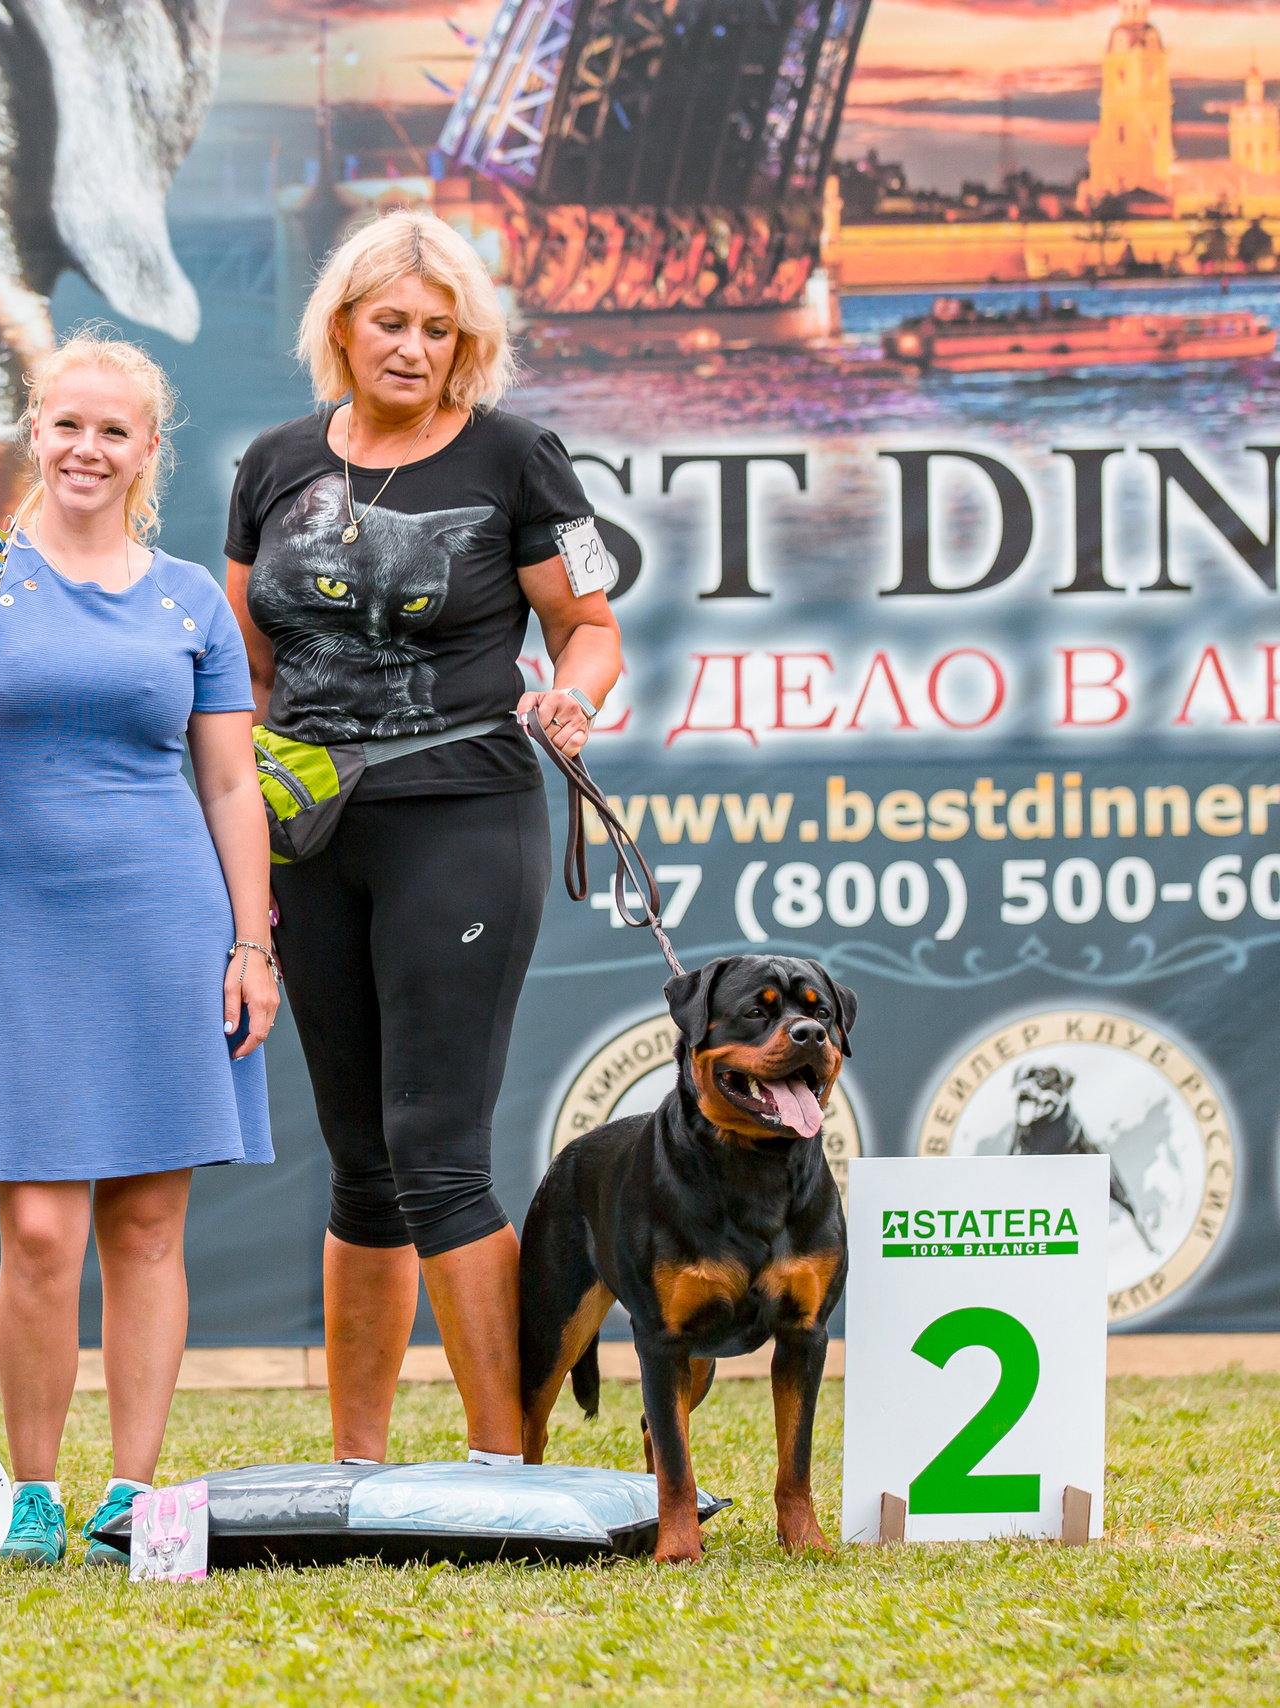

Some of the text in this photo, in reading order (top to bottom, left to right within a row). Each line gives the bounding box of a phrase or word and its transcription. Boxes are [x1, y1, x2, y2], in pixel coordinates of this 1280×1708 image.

[580, 538, 604, 574] 29
[878, 445, 1280, 598] DIN
[664, 648, 1008, 748] ДЕЛО
[1054, 646, 1131, 728] В
[590, 864, 703, 930] +7
[734, 858, 968, 943] (800)
[583, 1031, 673, 1107] КИНОЛ
[926, 1018, 1232, 1240] ВЕЙЛЕР КЛУБ РОССИИ
[910, 1243, 1048, 1256] 100% BALANCE
[913, 1208, 1078, 1239] STATERA
[908, 1306, 1040, 1514] 2
